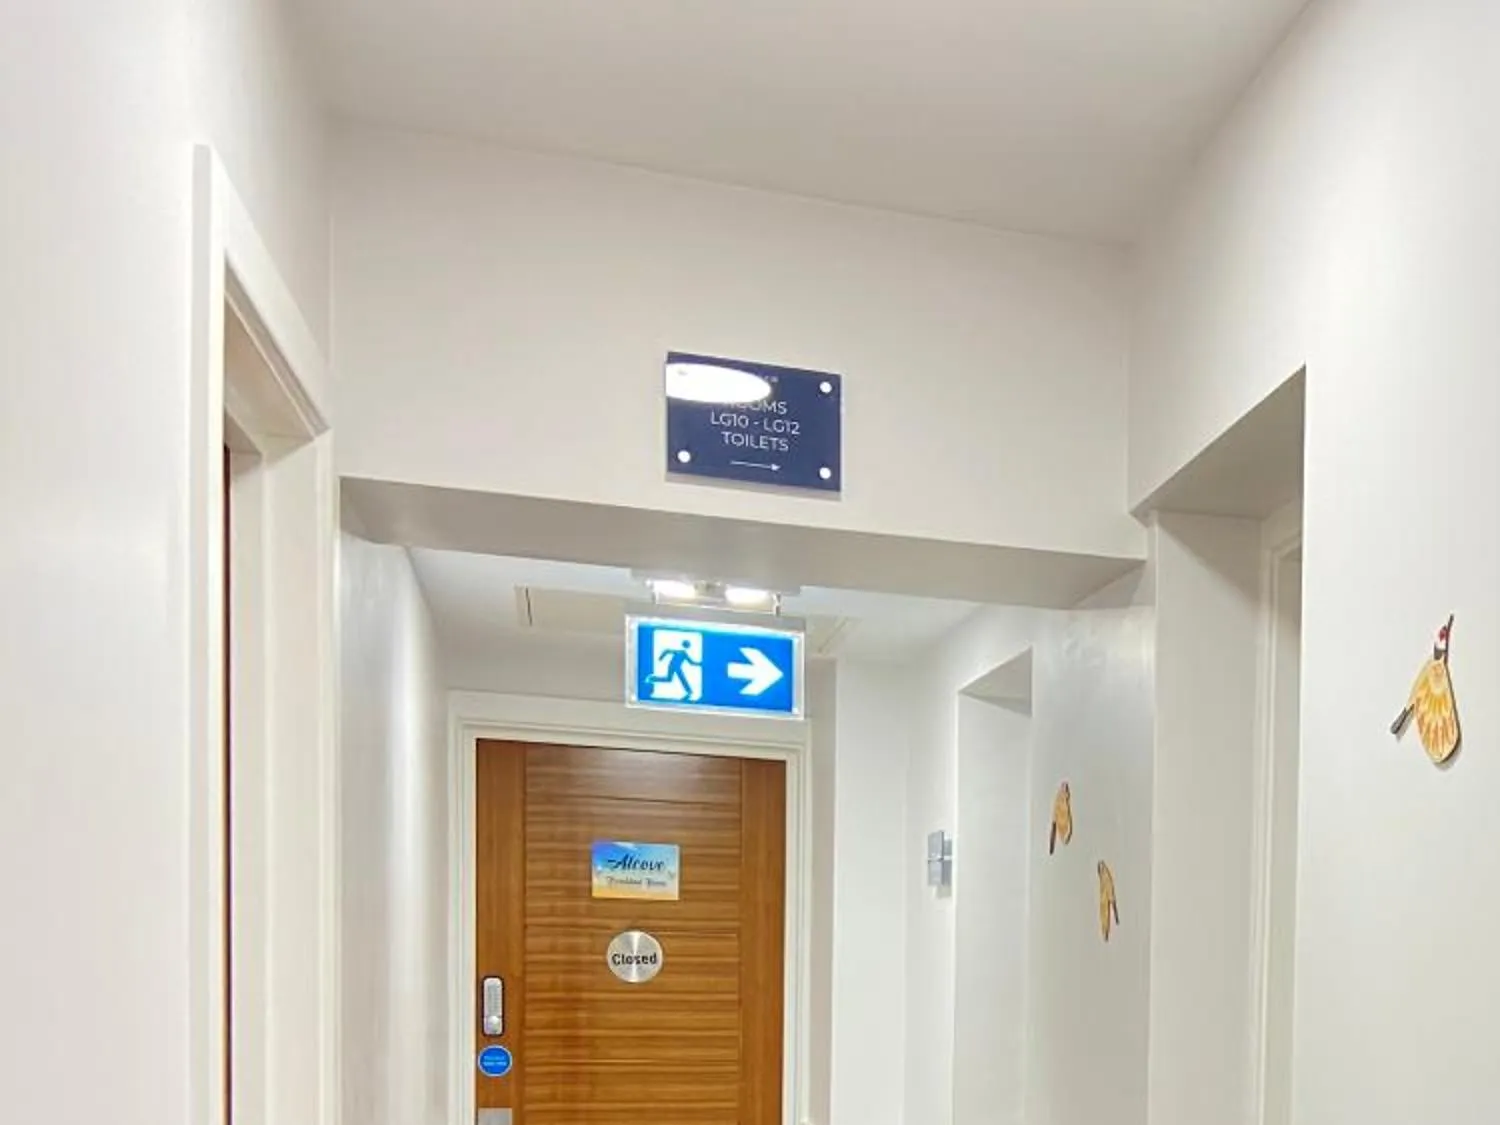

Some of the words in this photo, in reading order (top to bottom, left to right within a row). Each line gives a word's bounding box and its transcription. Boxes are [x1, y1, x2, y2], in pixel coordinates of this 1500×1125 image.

[711, 410, 749, 428] LG10
[763, 418, 800, 435] LG12
[721, 431, 789, 451] TOILETS
[607, 853, 665, 871] Alcove
[611, 953, 657, 965] Closed
